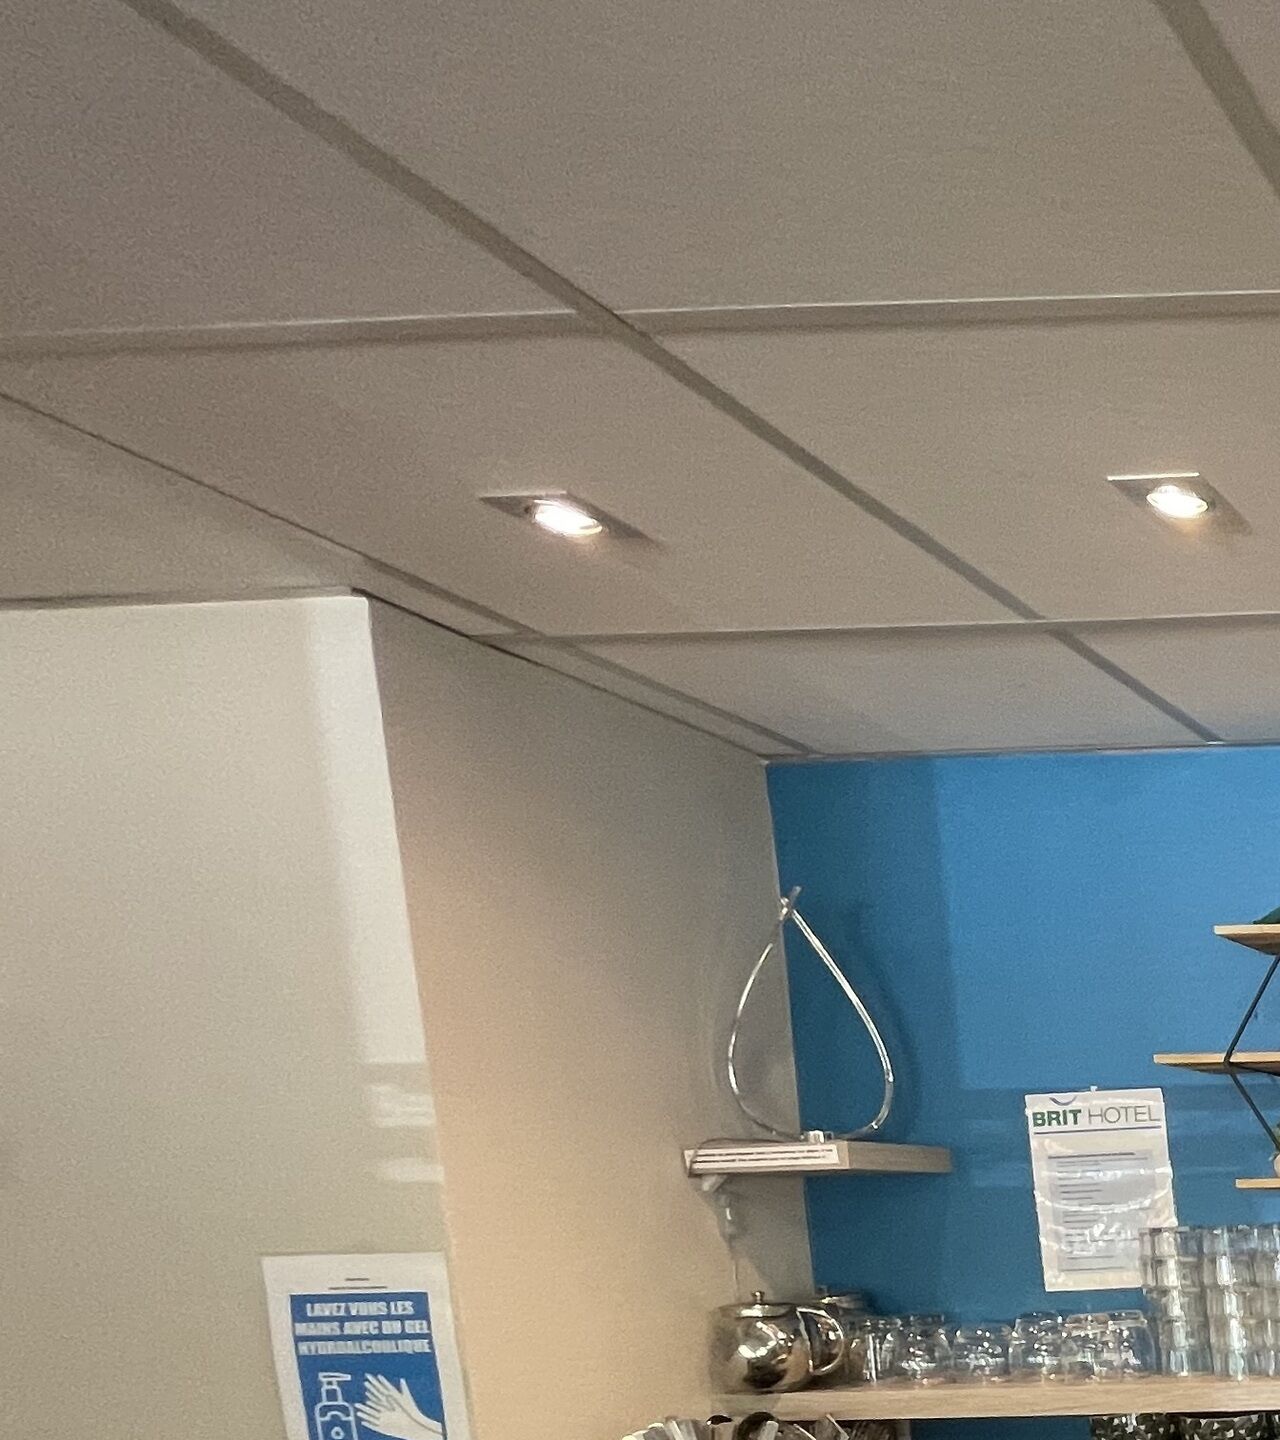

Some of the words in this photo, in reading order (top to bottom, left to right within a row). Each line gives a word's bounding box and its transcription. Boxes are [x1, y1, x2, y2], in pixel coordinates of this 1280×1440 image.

[1032, 1109, 1082, 1127] BRIT
[1088, 1104, 1161, 1125] HOTEL
[390, 1300, 415, 1316] LES
